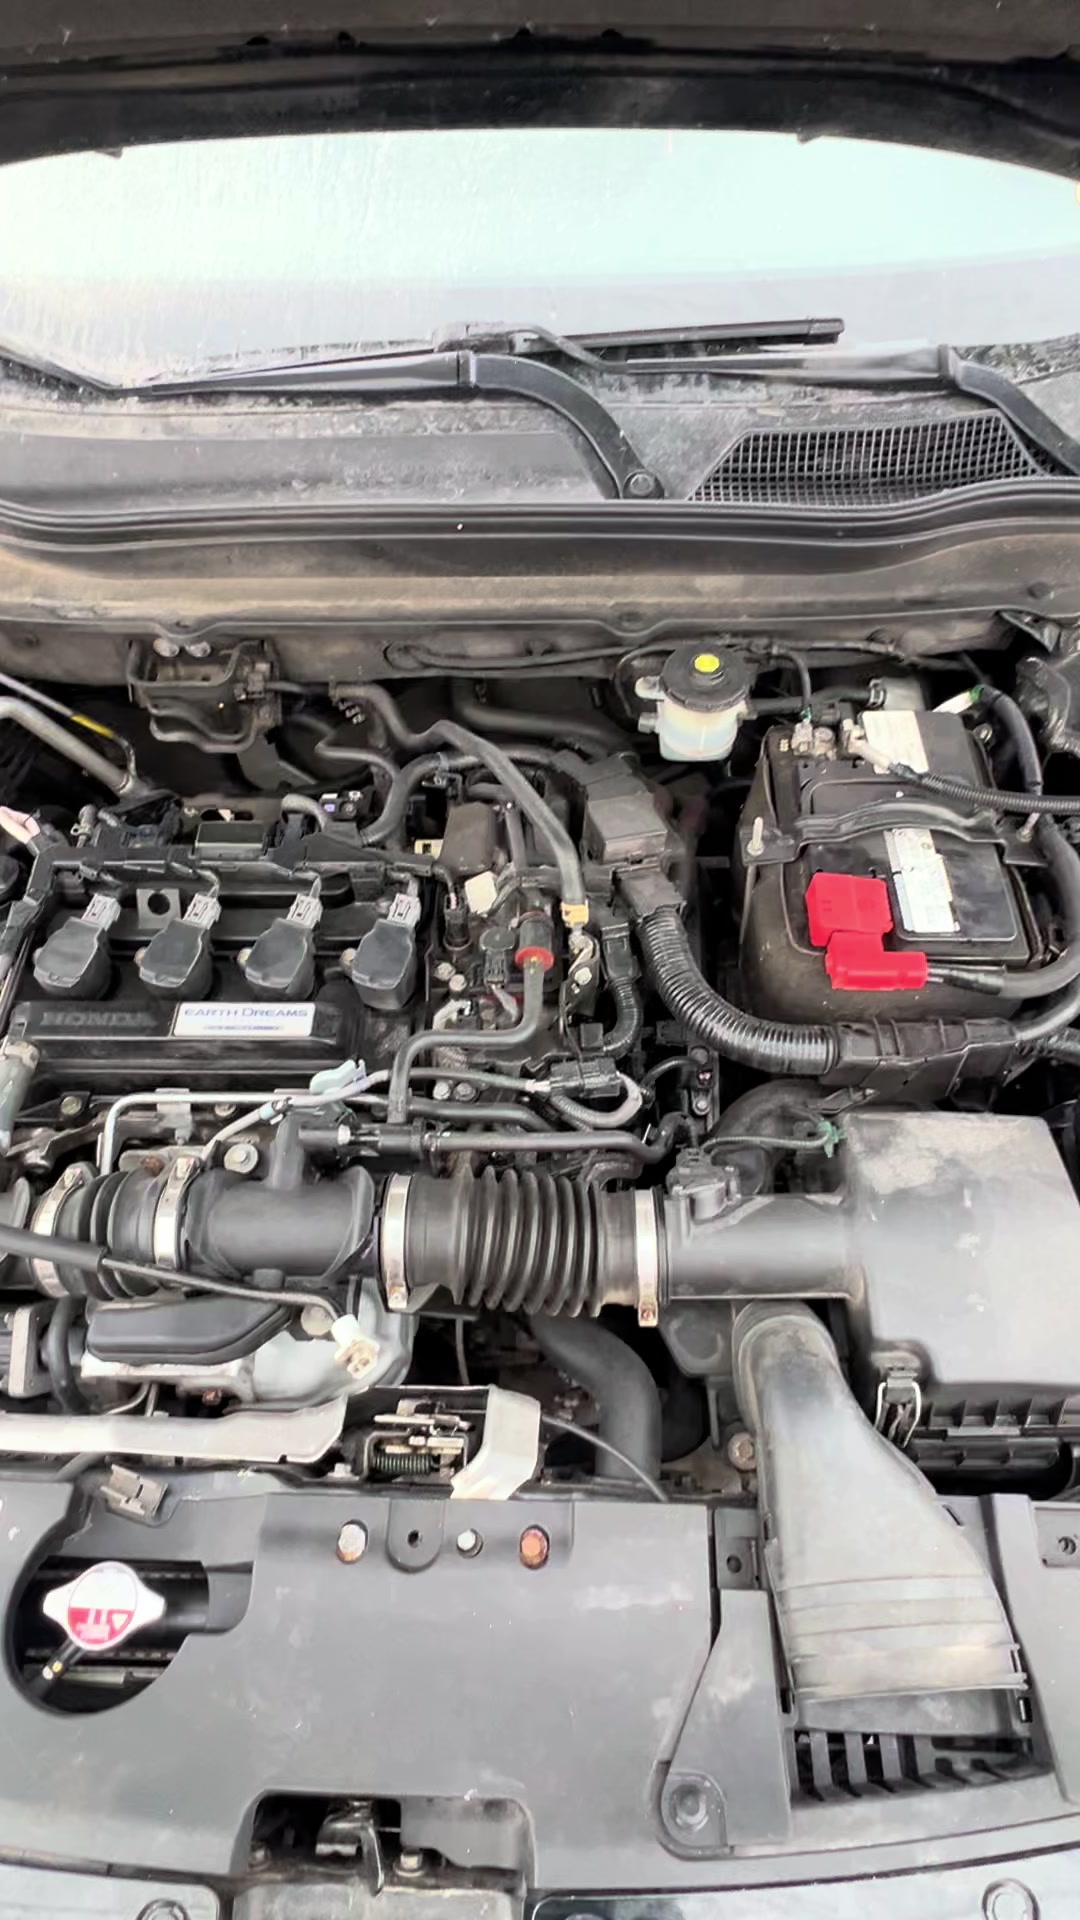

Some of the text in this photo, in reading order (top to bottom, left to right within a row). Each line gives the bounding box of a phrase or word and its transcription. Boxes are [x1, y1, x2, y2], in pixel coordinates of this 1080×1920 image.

[184, 1007, 308, 1017] EARTH DREAMS
[40, 1011, 157, 1026] HONDA
